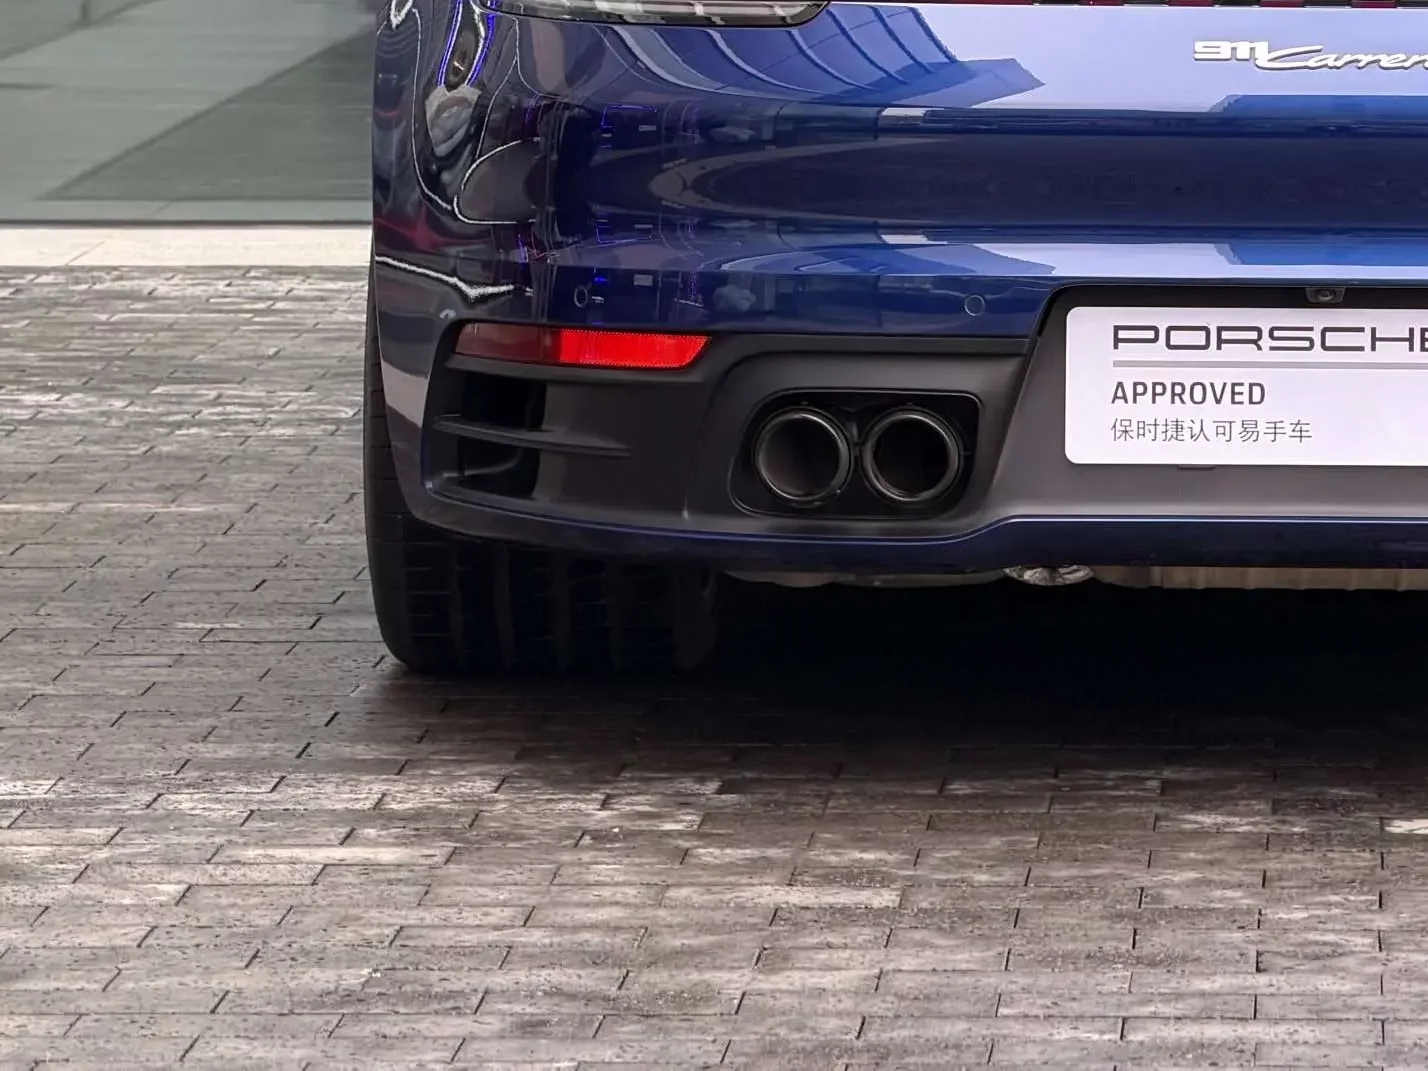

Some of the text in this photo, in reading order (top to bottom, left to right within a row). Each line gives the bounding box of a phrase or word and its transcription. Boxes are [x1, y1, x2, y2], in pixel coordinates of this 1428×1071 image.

[1193, 40, 1268, 60] 911
[1111, 381, 1266, 405] APPROVED
[1110, 418, 1313, 443] 保时捷认可易手车
